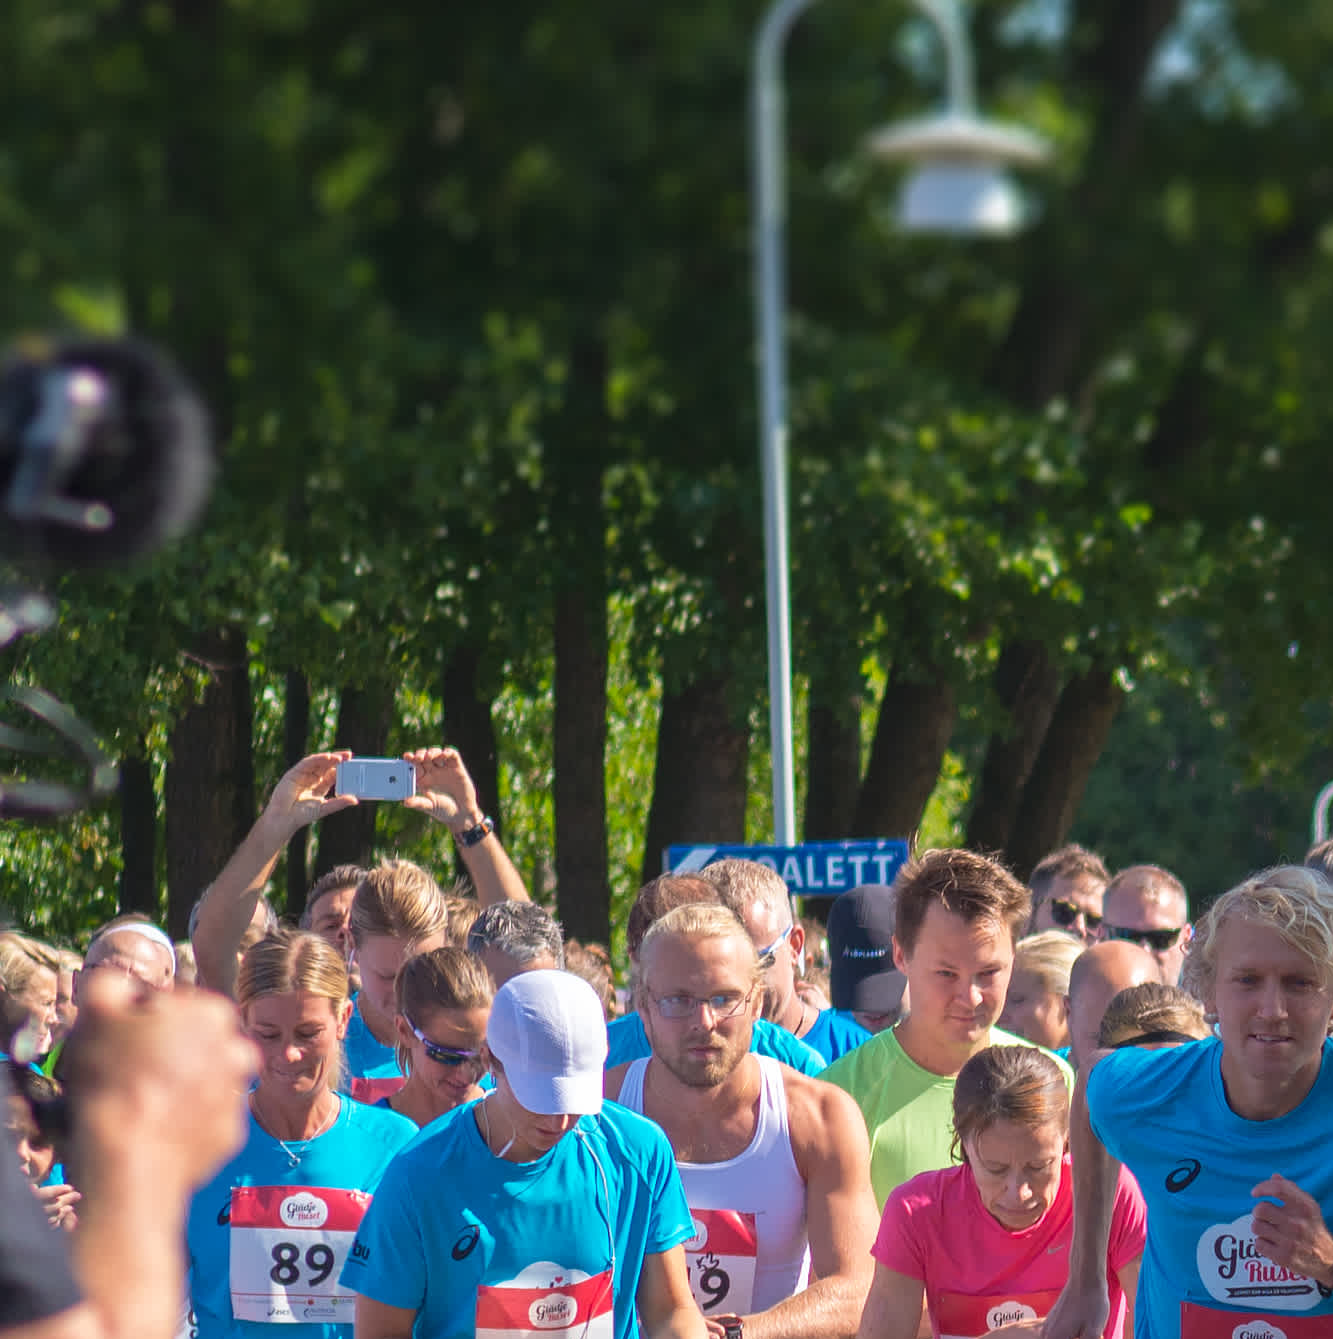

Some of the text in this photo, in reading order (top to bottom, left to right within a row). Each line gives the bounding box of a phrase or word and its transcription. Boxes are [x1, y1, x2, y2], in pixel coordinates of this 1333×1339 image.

[270, 1242, 335, 1287] 89
[1214, 1235, 1263, 1279] Glä
[1245, 1260, 1308, 1282] Ruse
